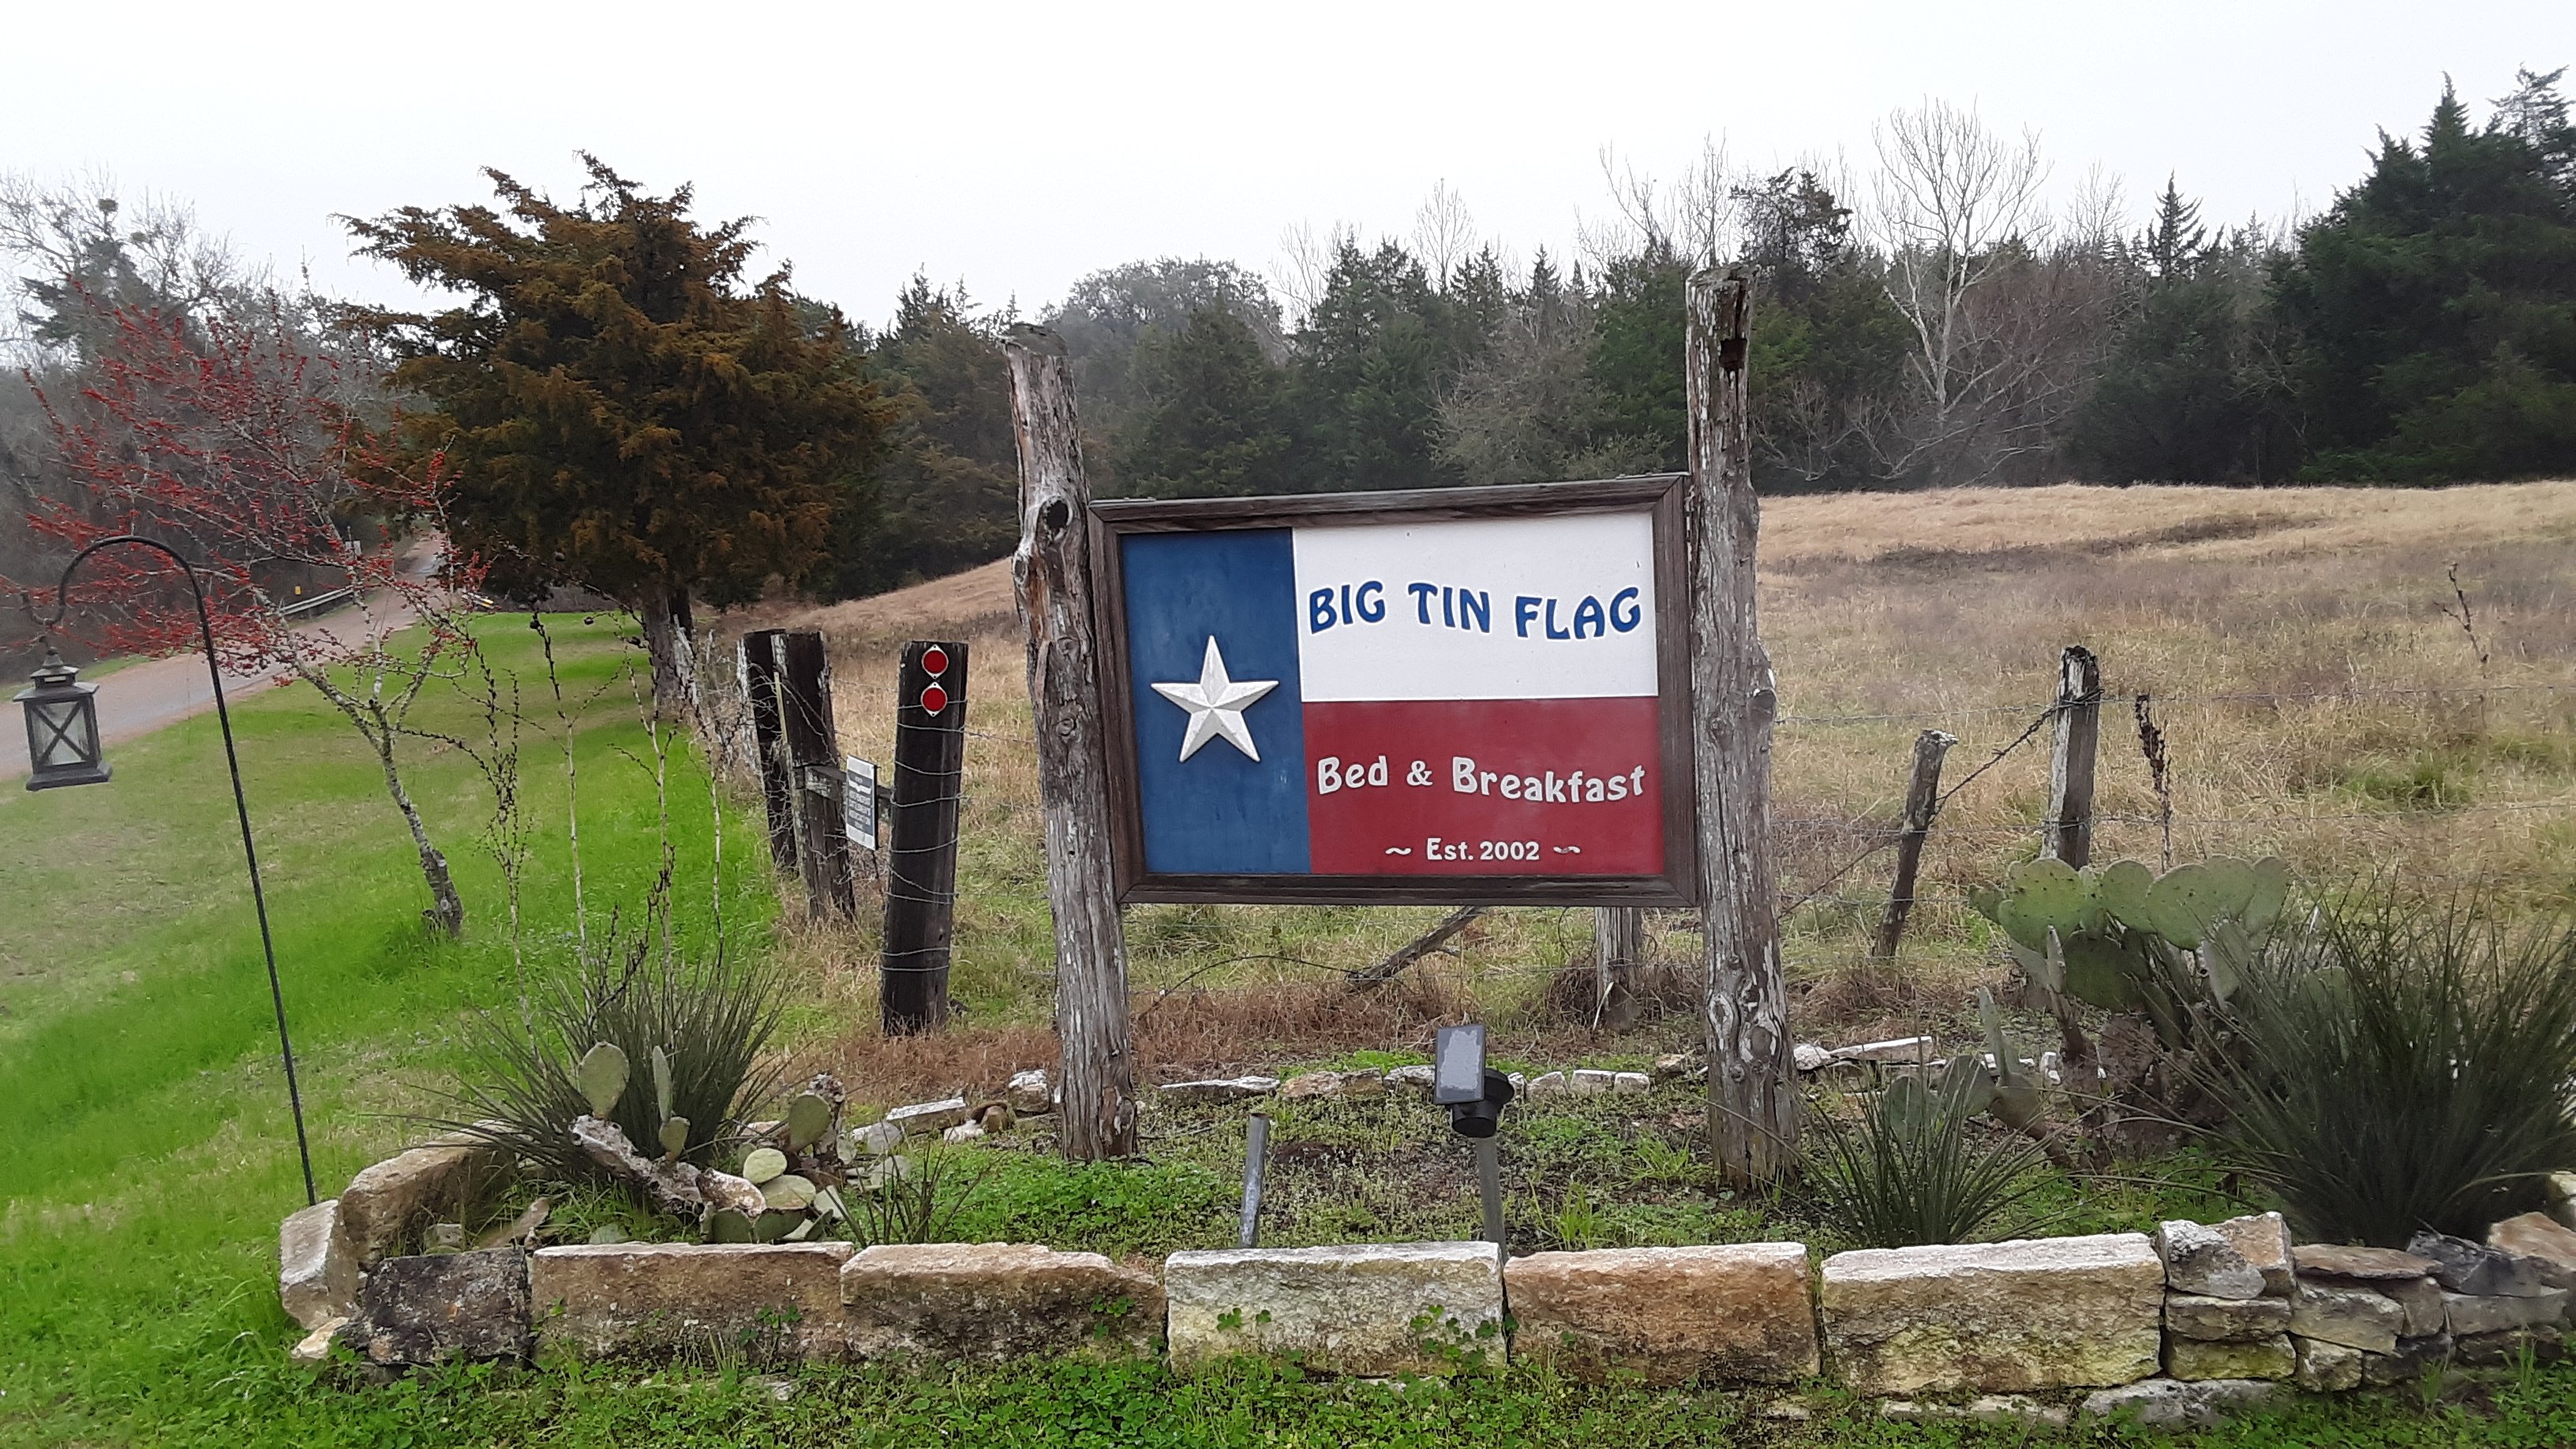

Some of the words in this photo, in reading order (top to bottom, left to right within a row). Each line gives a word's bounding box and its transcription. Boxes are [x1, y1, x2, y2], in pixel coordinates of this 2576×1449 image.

[1309, 580, 1386, 634] BIG
[1408, 582, 1491, 633] TIN
[1515, 587, 1641, 639] FLAG
[1317, 755, 1388, 795] Bed
[1406, 760, 1433, 786] &
[1452, 756, 1646, 803] Breakfast
[1426, 837, 1474, 861] Est.
[1479, 841, 1540, 860] 2002
